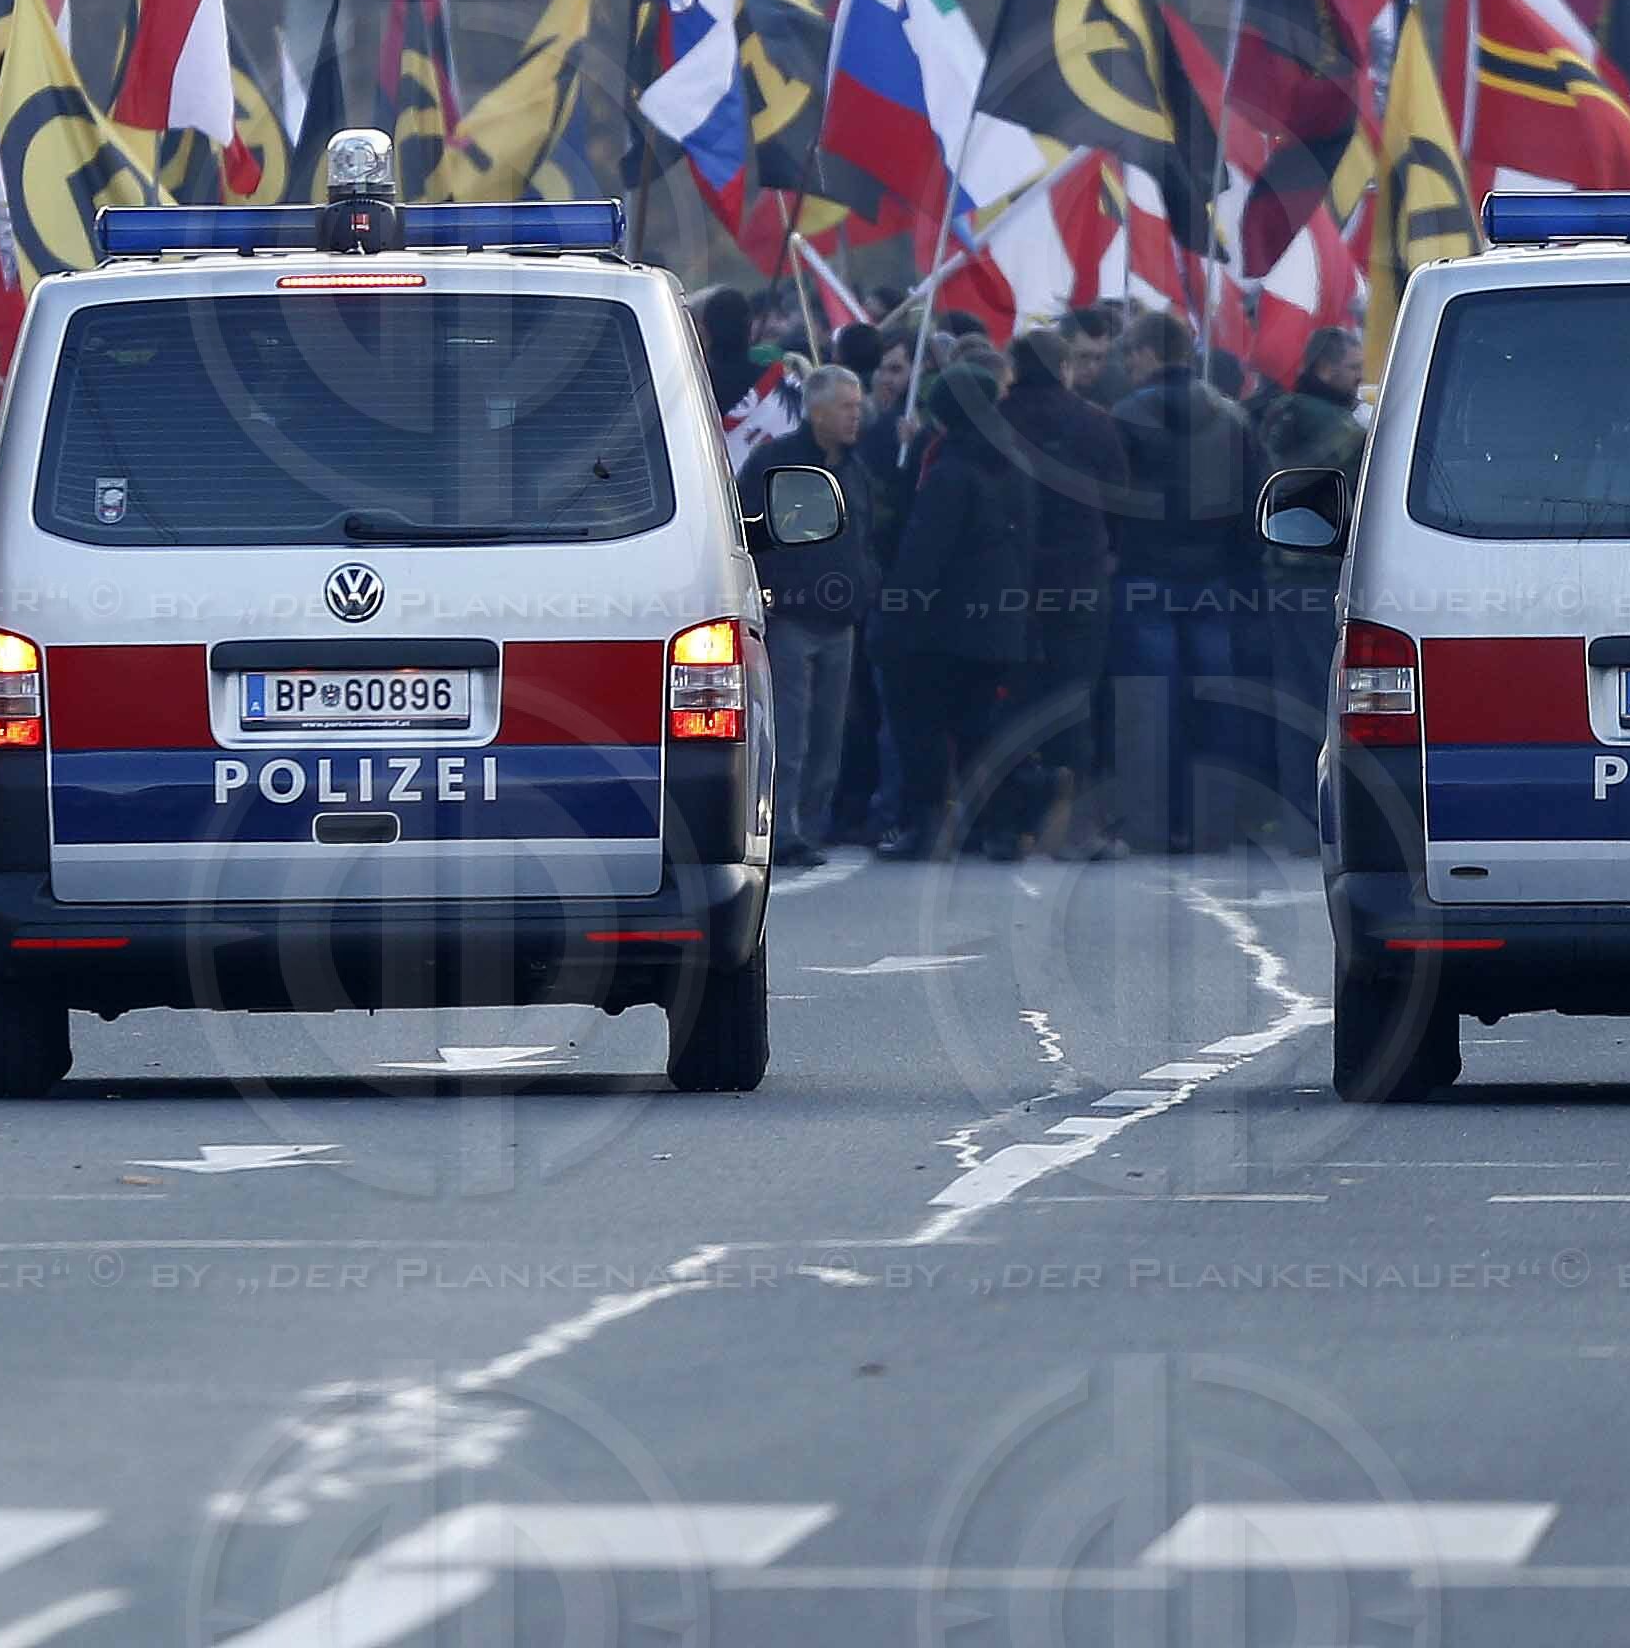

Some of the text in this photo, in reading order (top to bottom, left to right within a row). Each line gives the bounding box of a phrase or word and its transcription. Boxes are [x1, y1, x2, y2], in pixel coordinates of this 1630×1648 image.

[276, 678, 452, 712] BP 60896
[214, 756, 498, 804] POLIZEI
